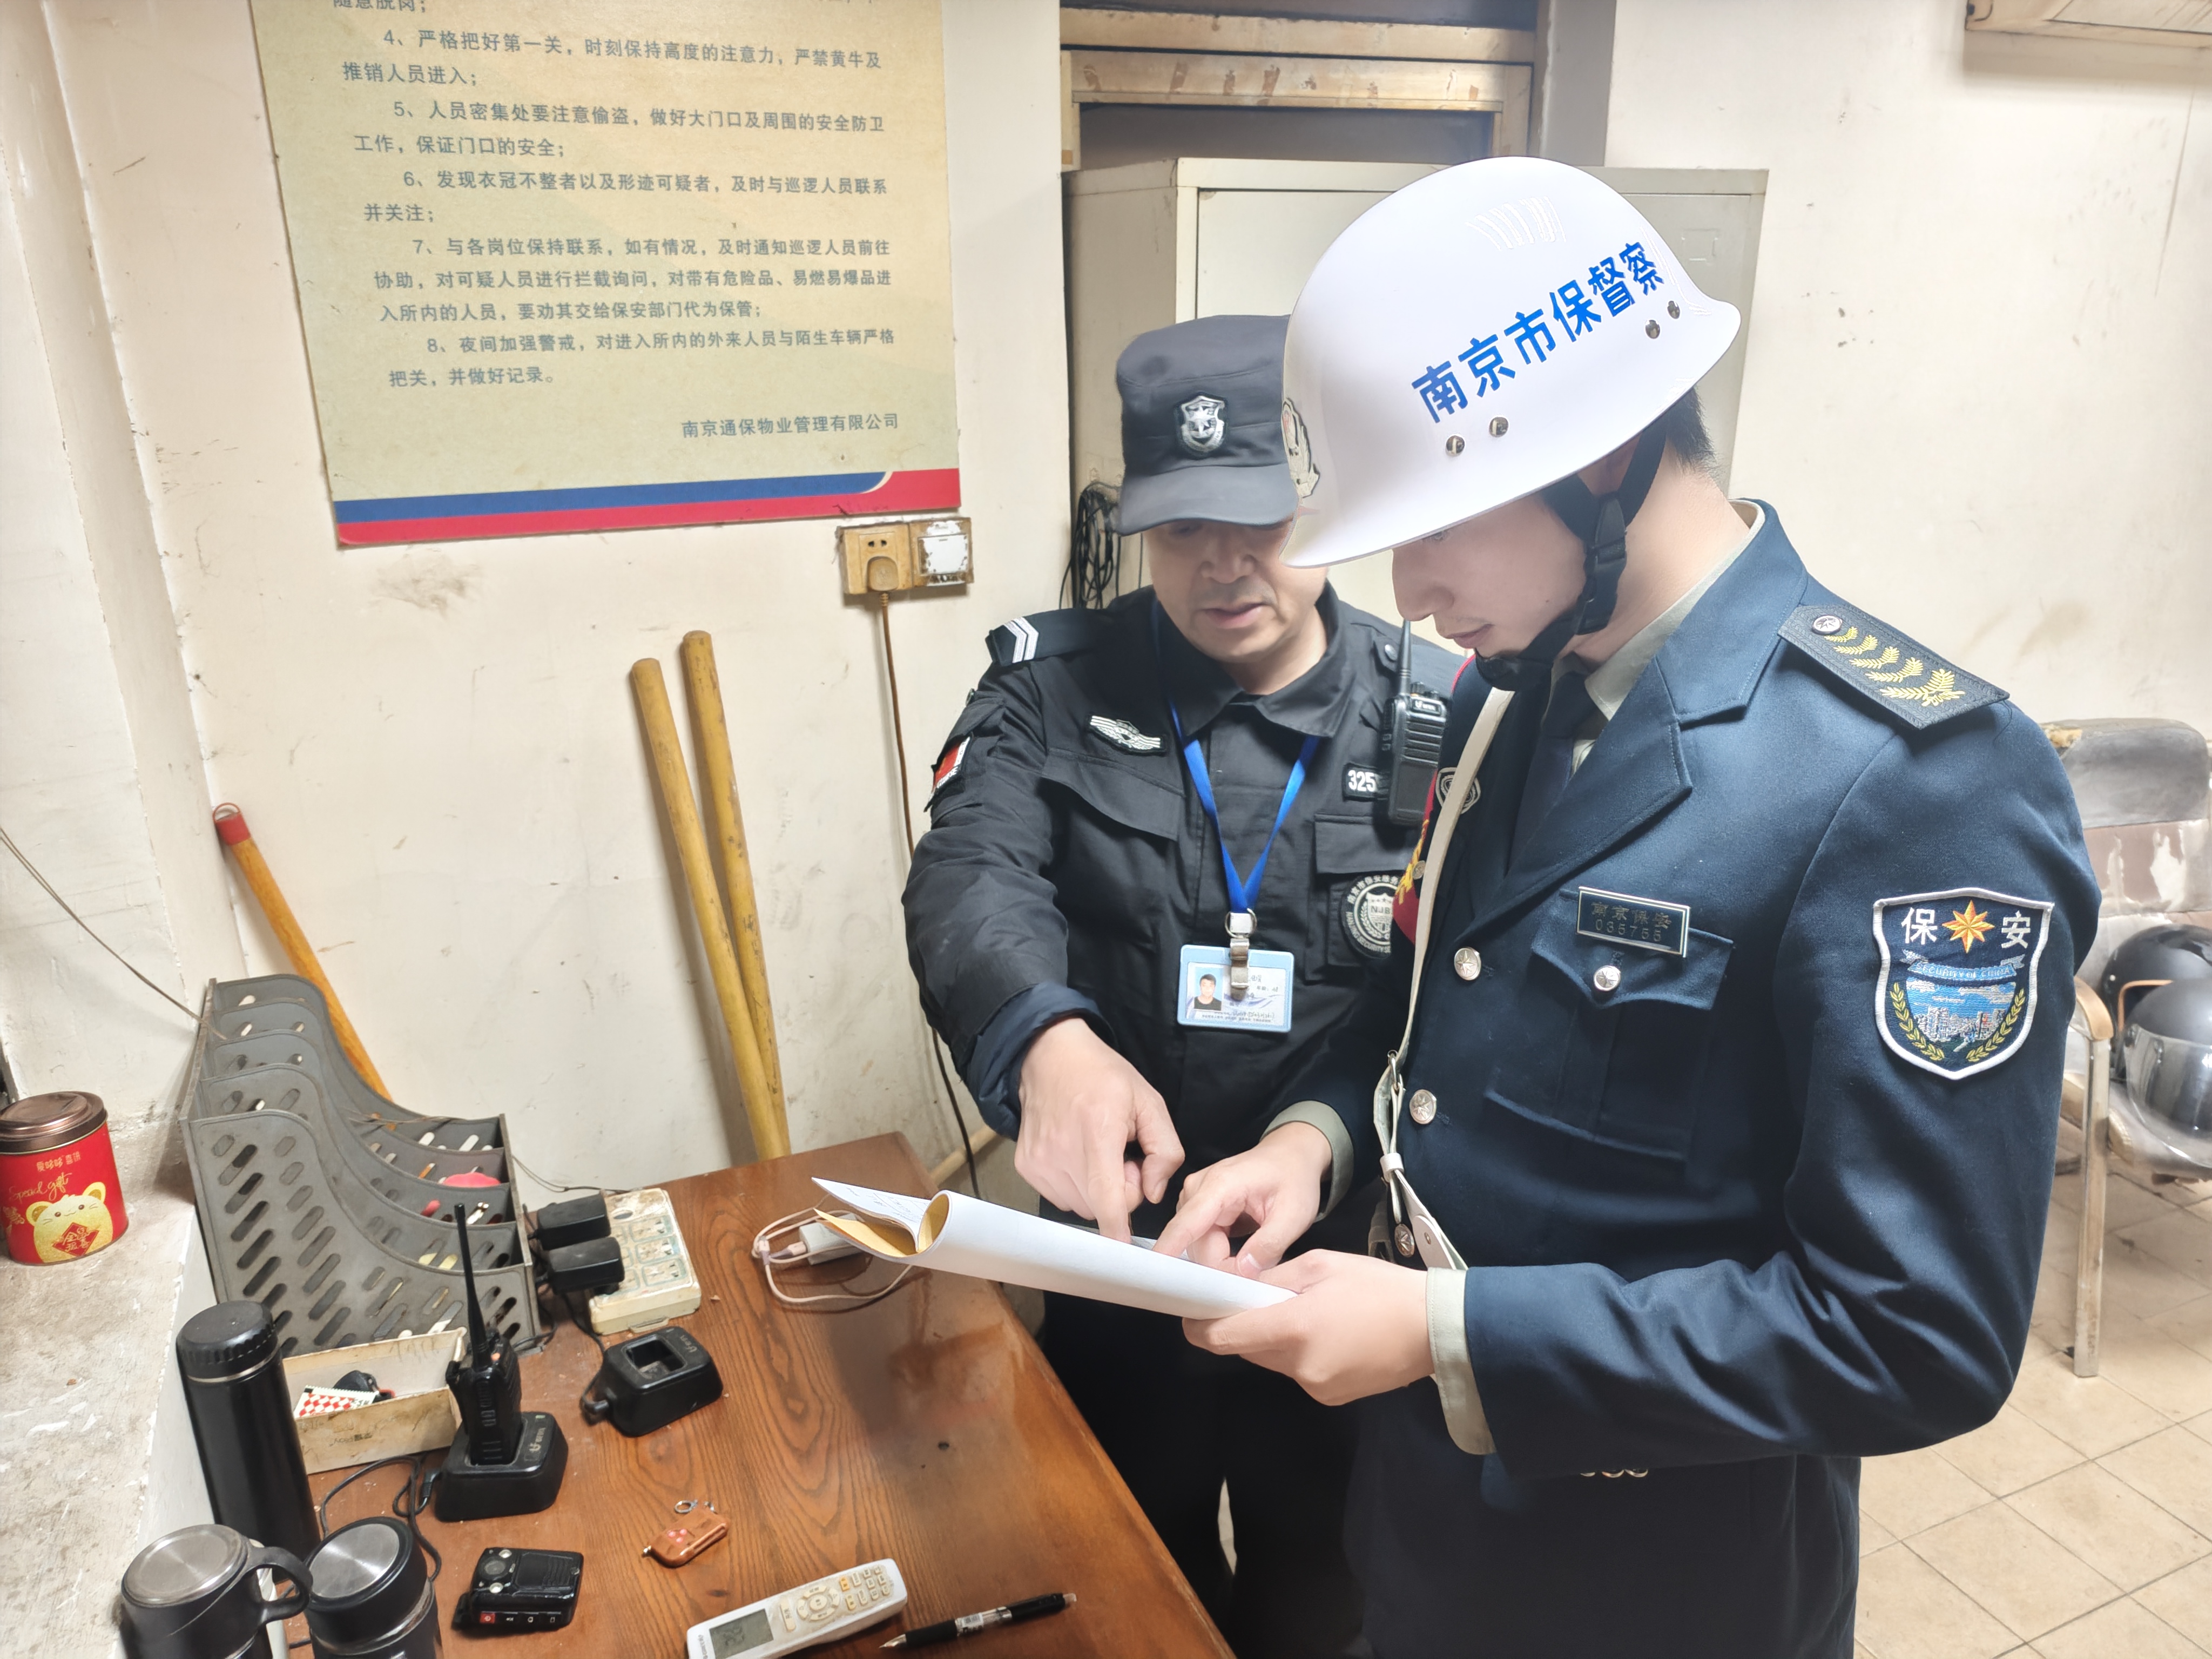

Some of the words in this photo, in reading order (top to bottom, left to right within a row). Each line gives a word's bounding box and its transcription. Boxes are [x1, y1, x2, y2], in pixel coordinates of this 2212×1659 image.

[342, 61, 476, 86] 推销人员进入；
[354, 134, 564, 158] 工作，保证门口的安全；
[363, 203, 434, 222] 并关注；
[1411, 242, 1664, 423] 南京市保督察
[389, 366, 553, 387] 把关，并做好记录。
[681, 413, 898, 439] 南京通保物业管理有限公司
[1348, 770, 1377, 792] 325
[1370, 906, 1392, 915] NJB
[1901, 907, 1938, 945] 保
[2001, 910, 2031, 948] 安
